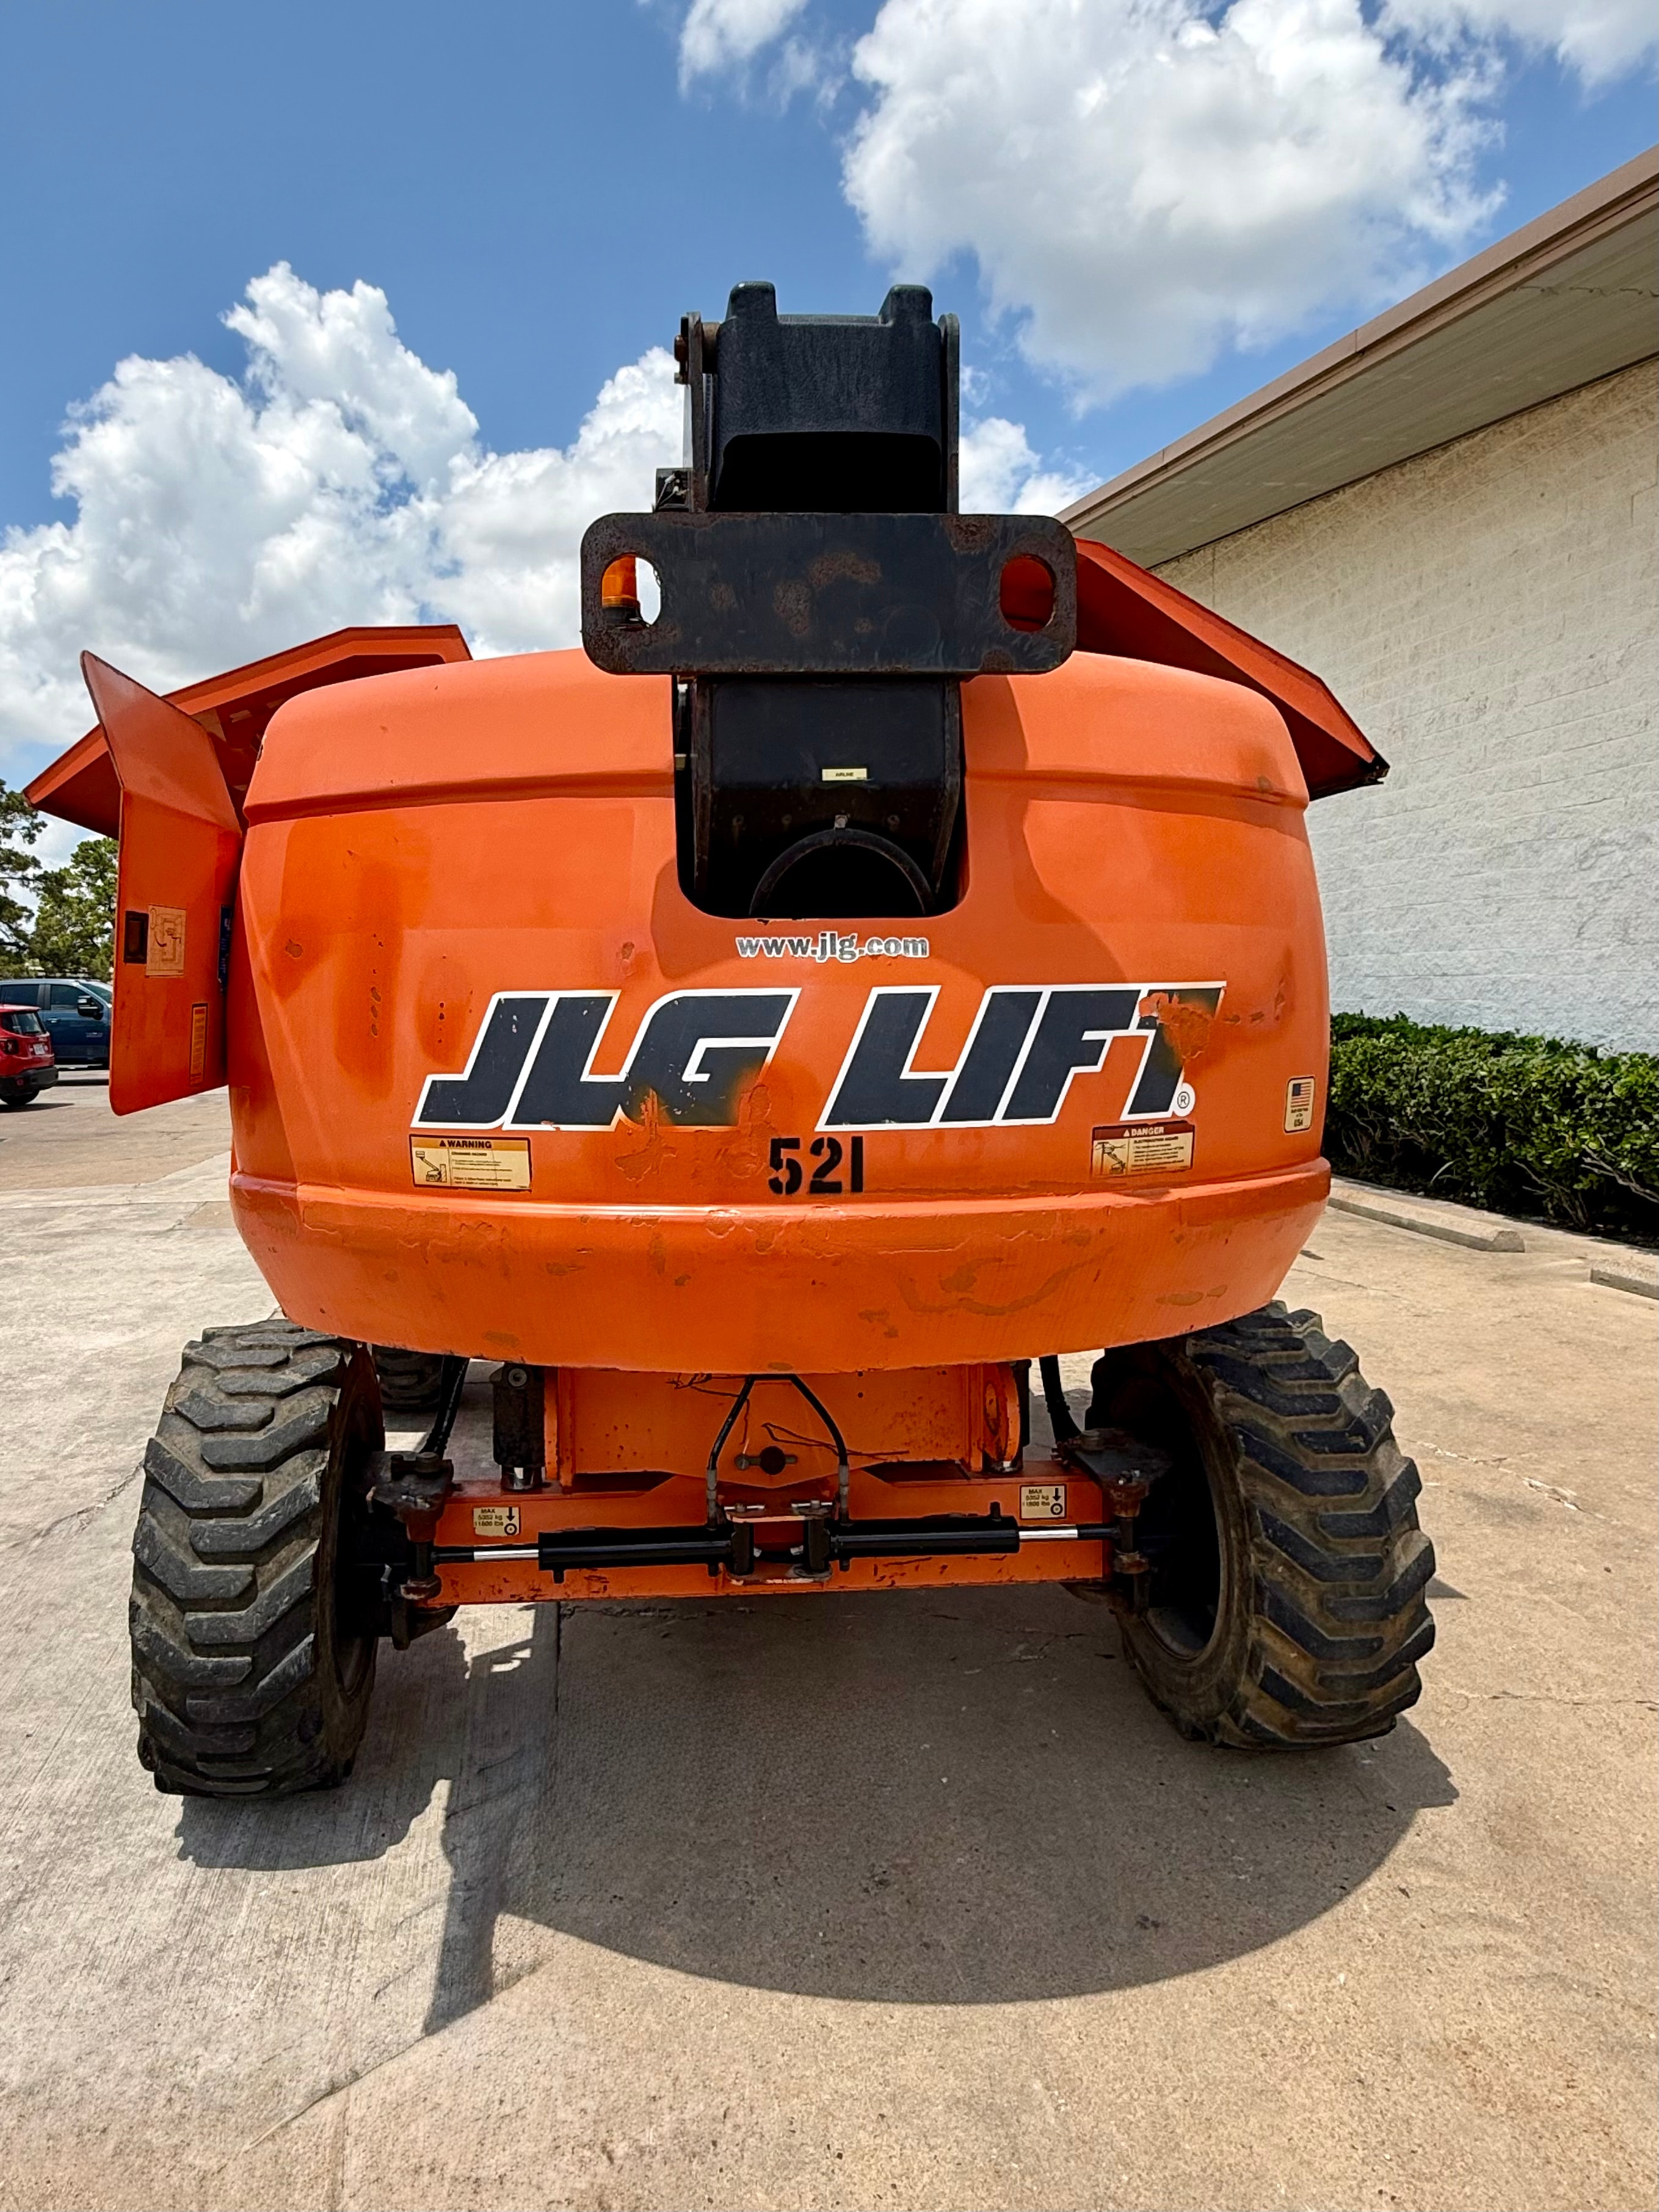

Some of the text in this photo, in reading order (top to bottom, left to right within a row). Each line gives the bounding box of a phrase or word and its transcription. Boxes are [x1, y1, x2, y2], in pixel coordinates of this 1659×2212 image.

[736, 931, 929, 963] www.jlg.com
[410, 987, 802, 1131] JLG
[447, 1140, 492, 1148] WARNING
[1131, 1127, 1164, 1137] DANGER
[768, 1136, 863, 1195] 521
